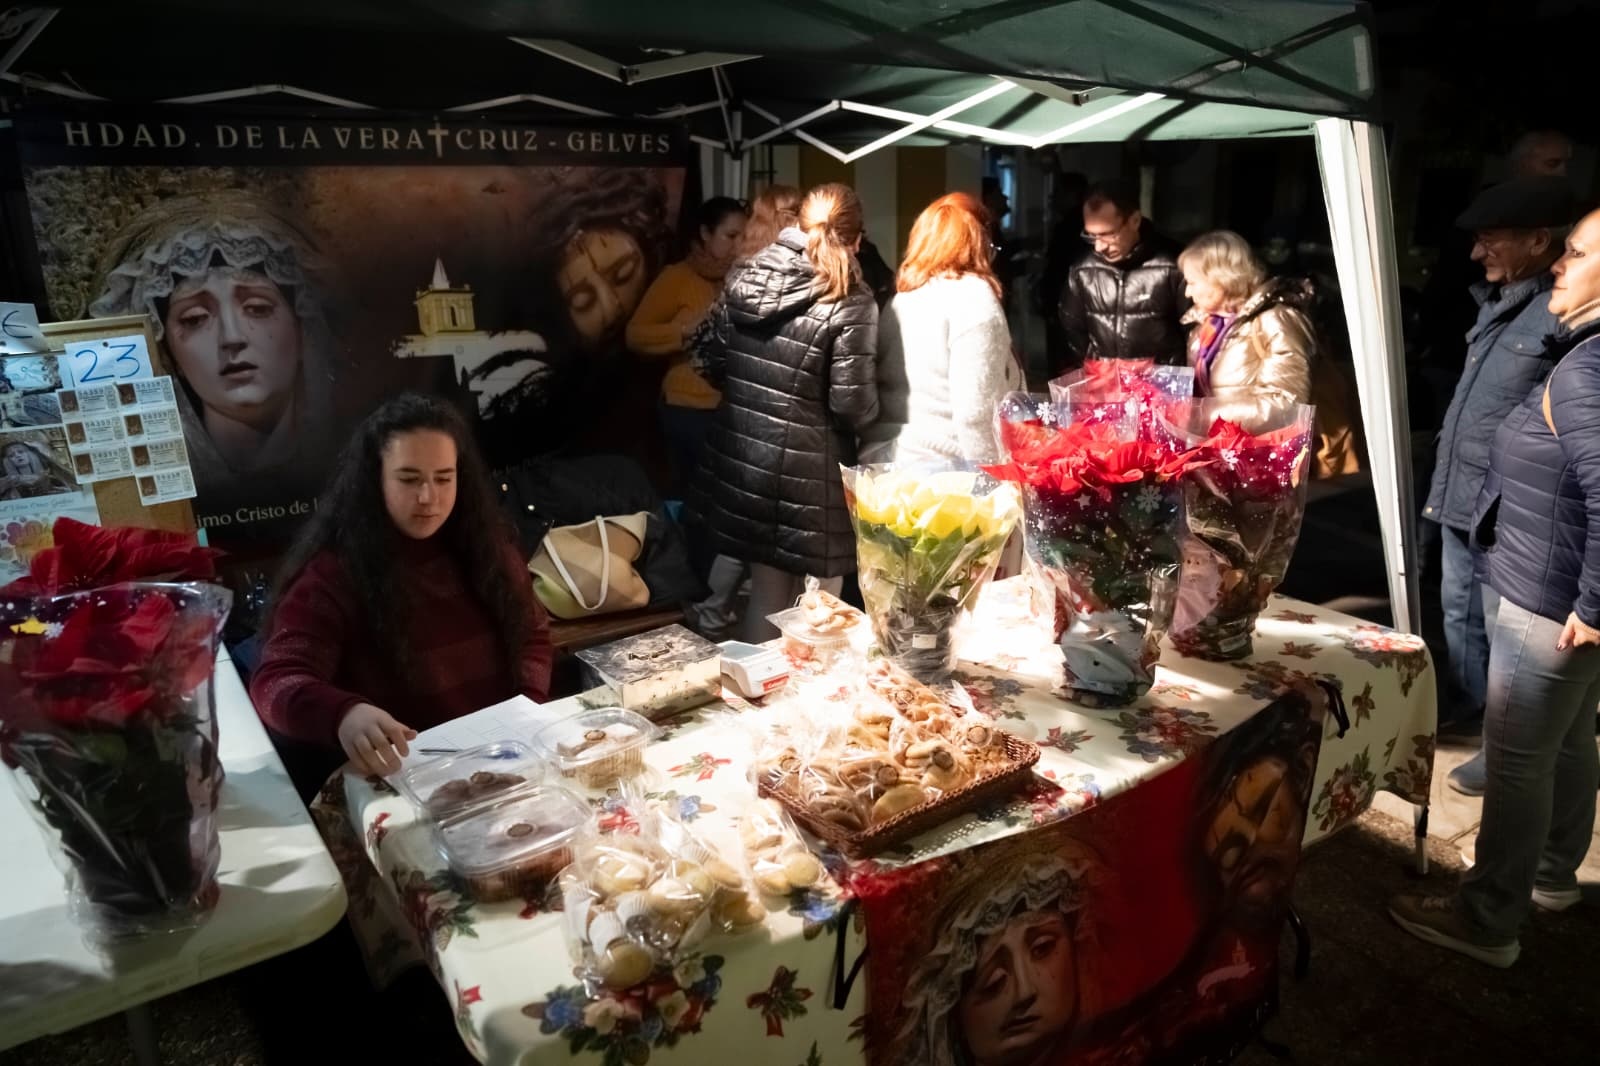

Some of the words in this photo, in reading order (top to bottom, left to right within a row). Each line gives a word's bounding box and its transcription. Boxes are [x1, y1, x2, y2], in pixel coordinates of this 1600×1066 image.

[64, 121, 201, 148] HDAD.
[215, 124, 264, 149] DE
[278, 126, 322, 149] LA
[333, 127, 425, 150] VERA
[455, 128, 538, 151] CRUZ
[567, 131, 671, 154] GELVES
[75, 343, 141, 383] 23
[195, 514, 232, 528] imo
[235, 505, 286, 524] Cristo
[289, 500, 310, 516] de
